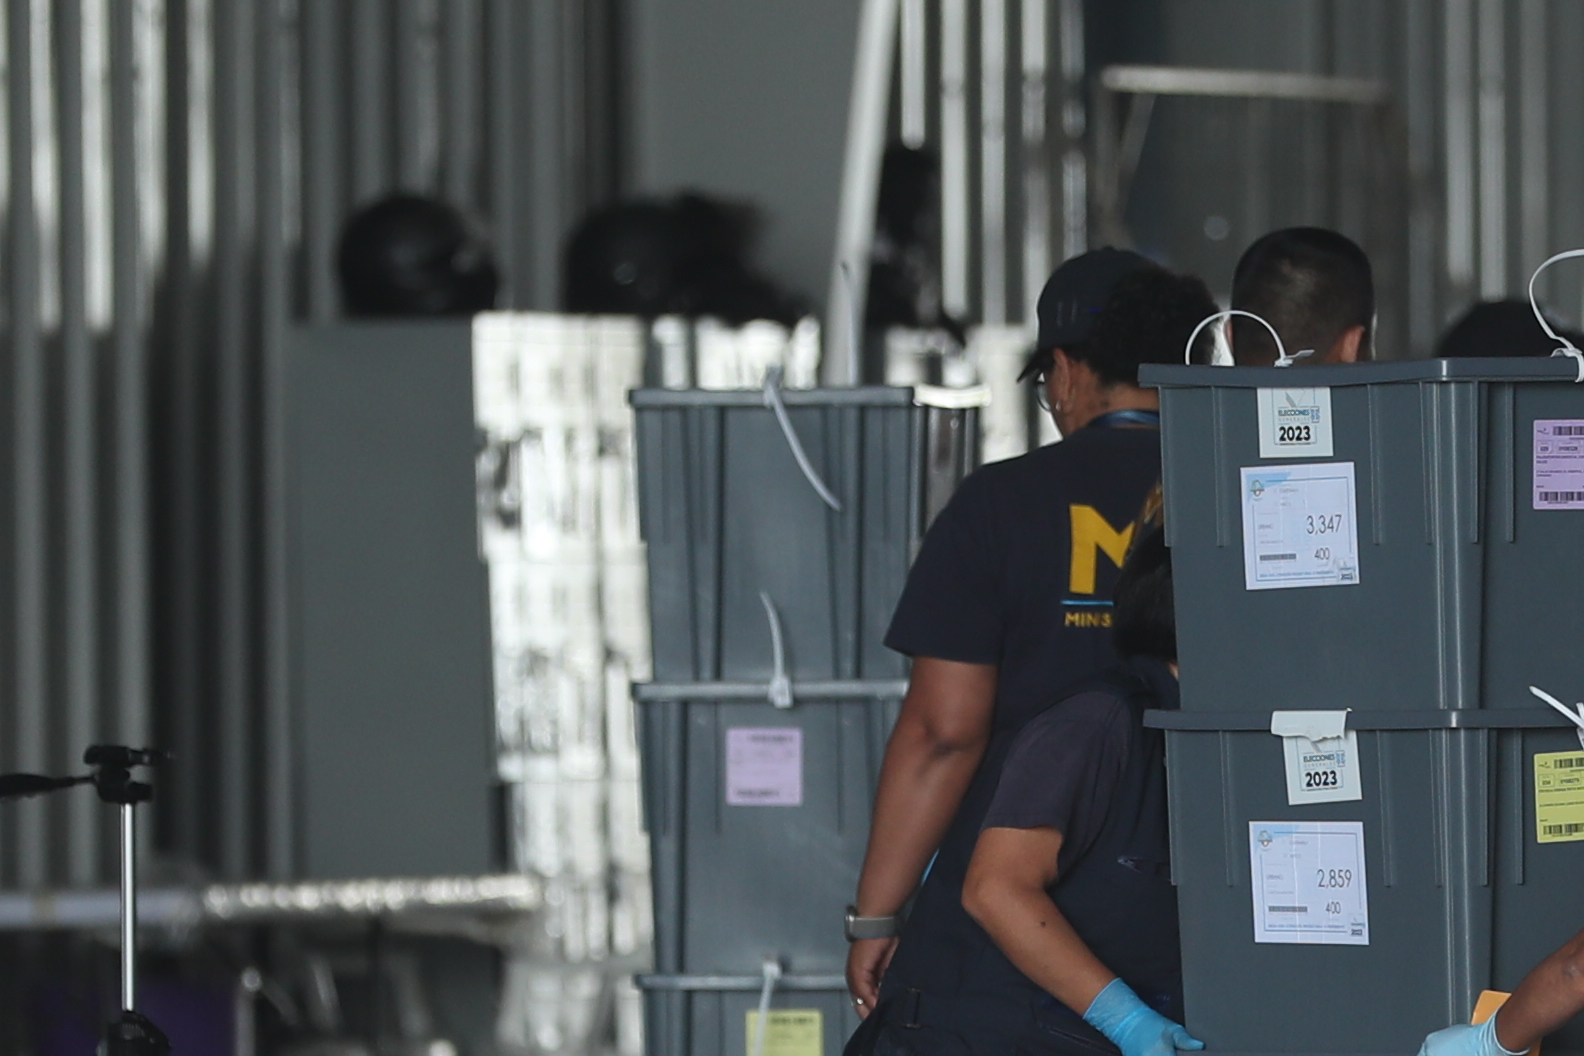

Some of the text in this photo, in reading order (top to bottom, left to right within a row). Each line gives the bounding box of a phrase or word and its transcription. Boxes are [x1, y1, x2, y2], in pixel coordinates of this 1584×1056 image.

[1278, 425, 1311, 442] 2023
[1306, 514, 1342, 535] 3,347
[1314, 547, 1331, 561] 400
[1305, 770, 1338, 788] 2023
[1316, 869, 1352, 889] 2,859
[1325, 901, 1341, 915] 400
